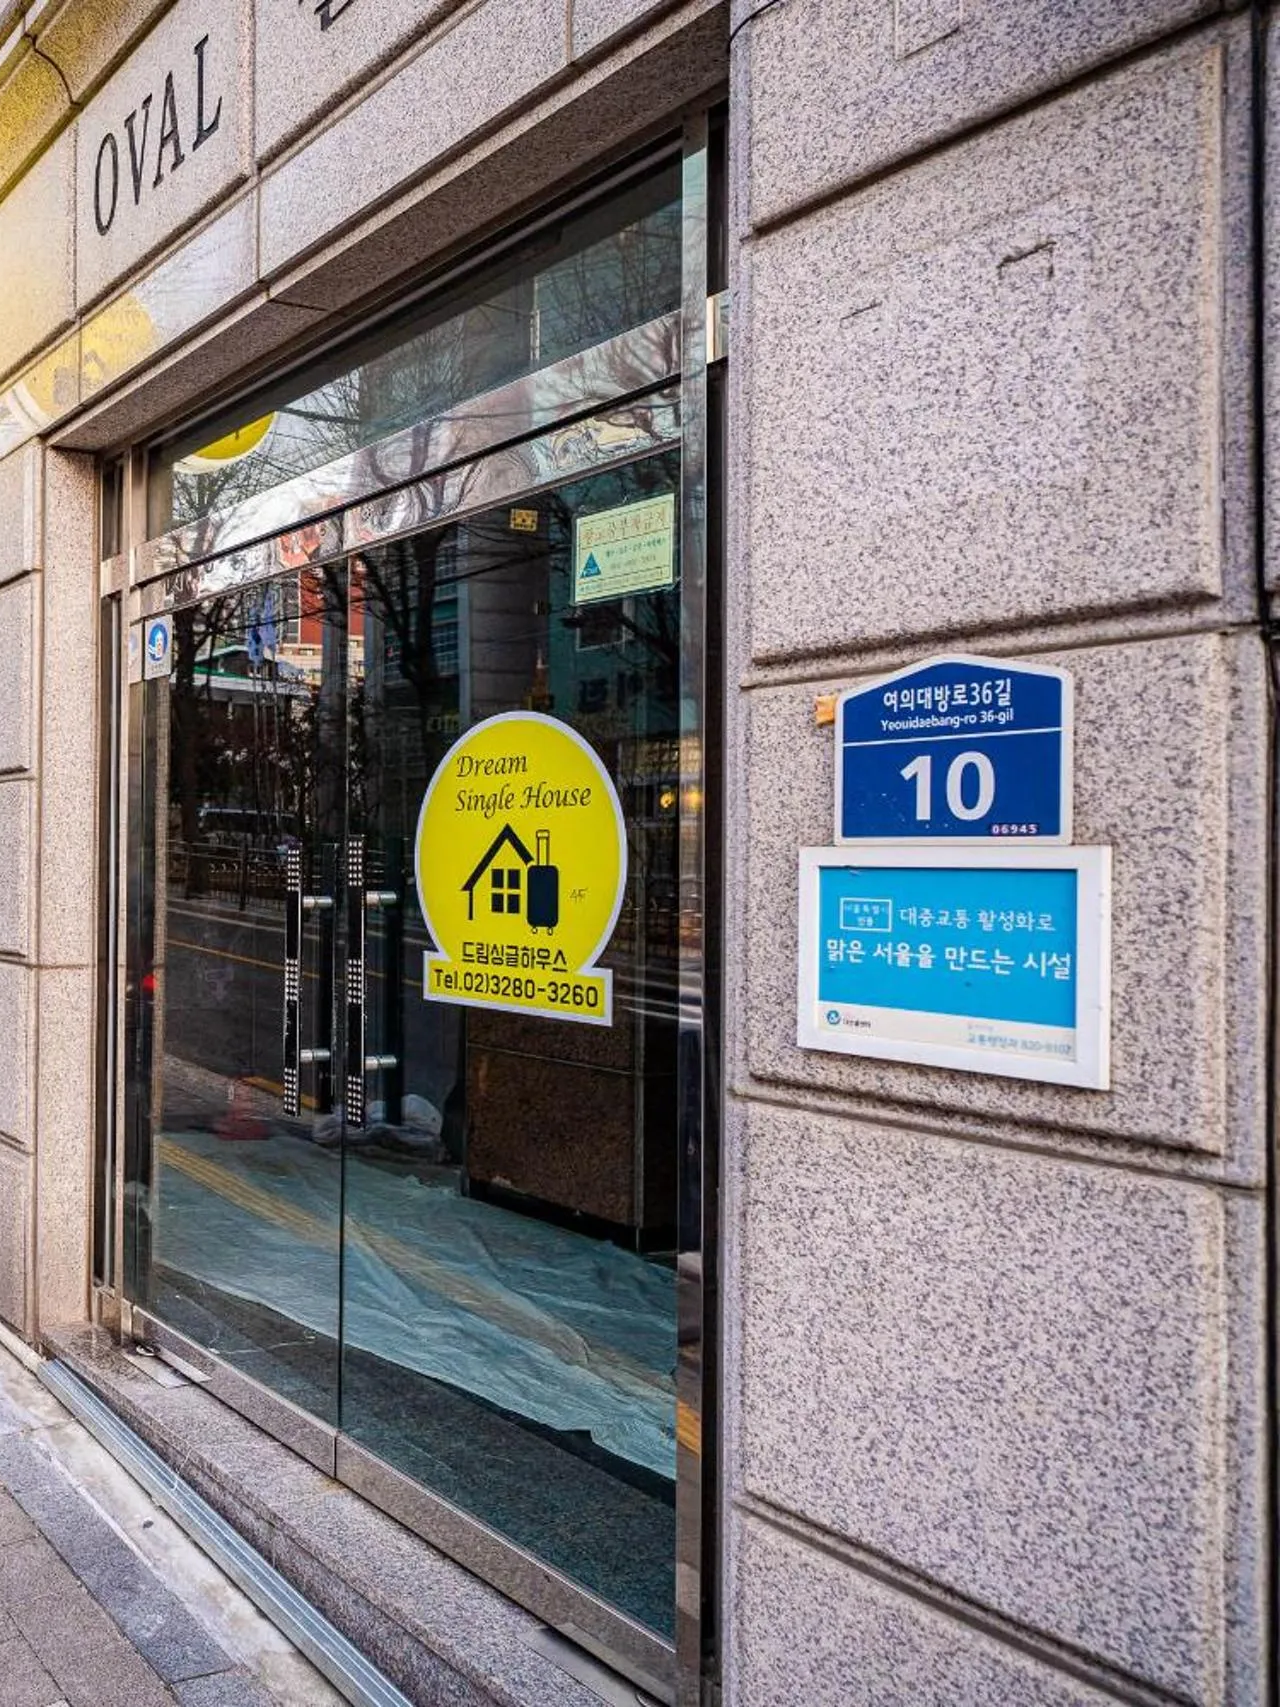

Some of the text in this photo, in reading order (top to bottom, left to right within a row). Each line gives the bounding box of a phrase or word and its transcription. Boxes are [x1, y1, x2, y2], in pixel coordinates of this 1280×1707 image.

[94, 33, 222, 236] OVAL
[883, 678, 1012, 712] 여의대방로36길
[881, 708, 1014, 731] Yeouidaebang-ro 36-gil
[456, 755, 528, 778] Dream
[455, 781, 592, 820] Single House
[900, 751, 995, 821] 10
[992, 824, 1038, 834] 06945
[900, 907, 1056, 933] 대중교통 활성화로
[462, 941, 568, 972] 드림싱글하우스
[826, 939, 1071, 981] 맑은 서울을 만드는 시설
[434, 968, 599, 1008] Tel.02)3280-3260
